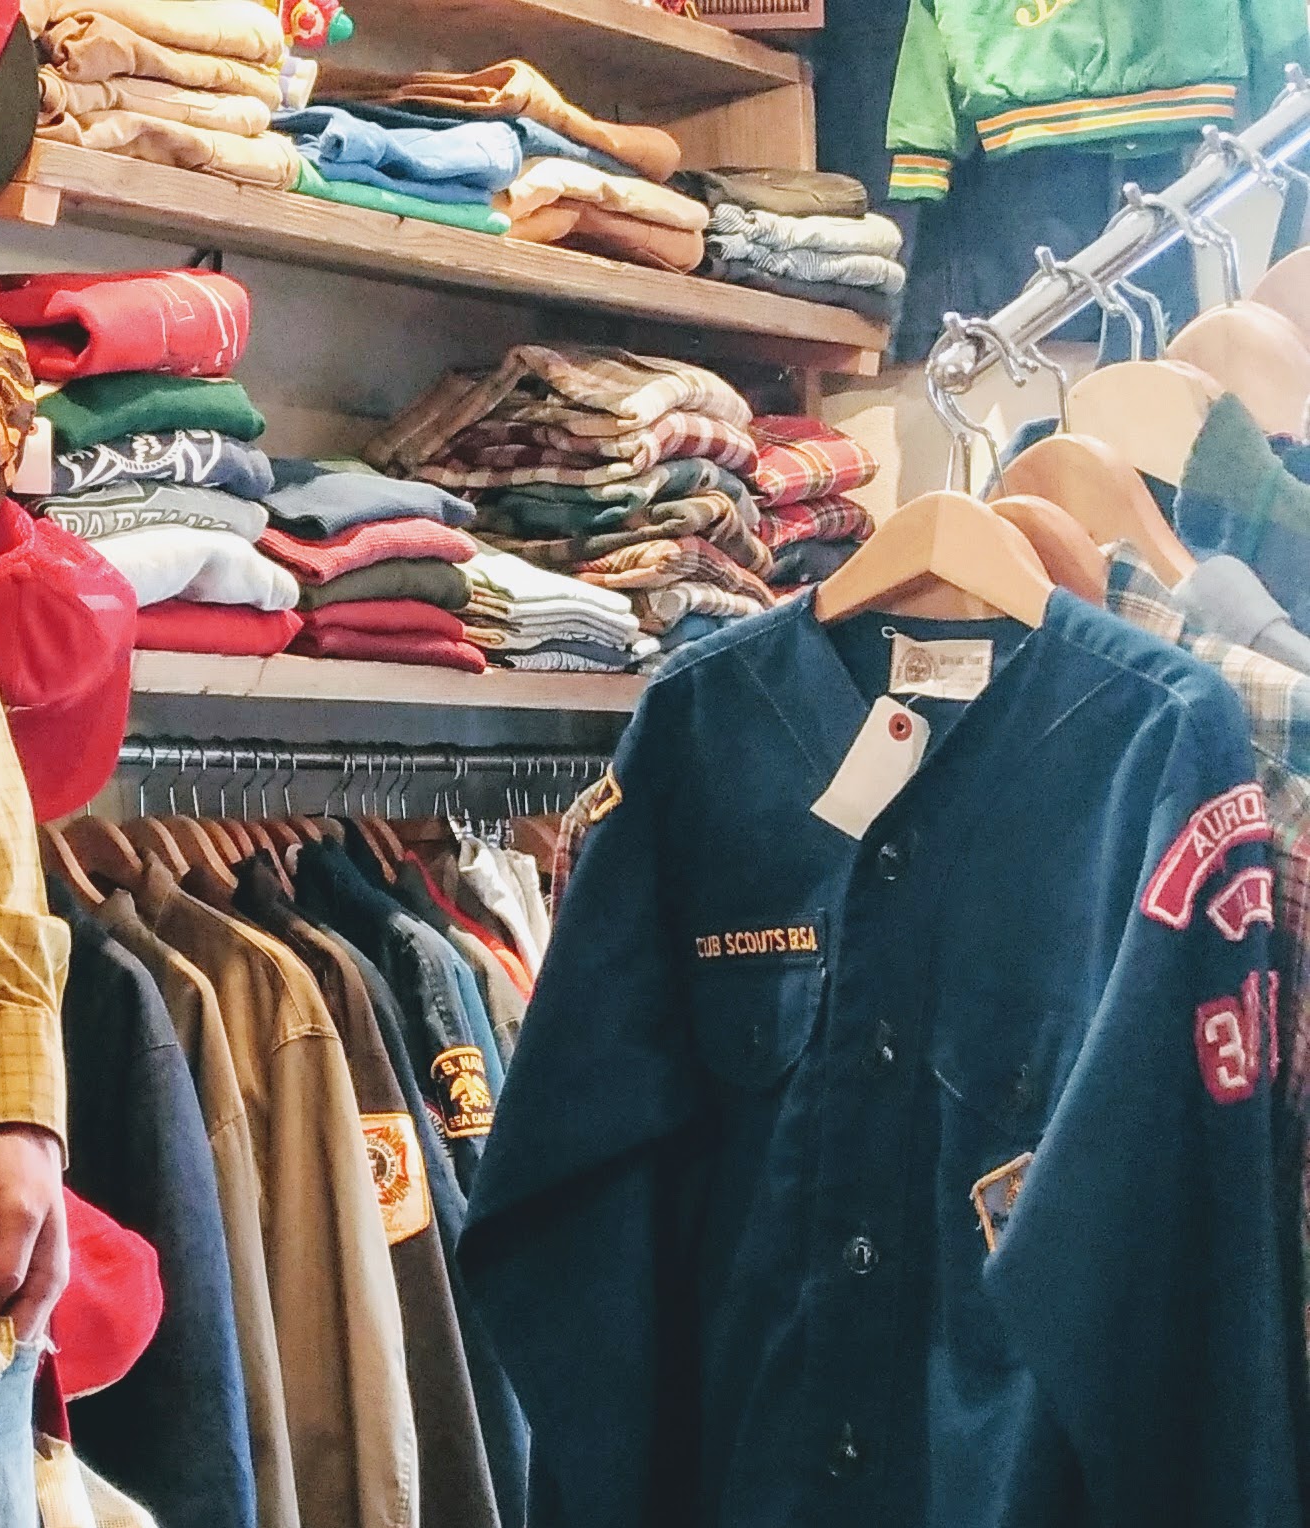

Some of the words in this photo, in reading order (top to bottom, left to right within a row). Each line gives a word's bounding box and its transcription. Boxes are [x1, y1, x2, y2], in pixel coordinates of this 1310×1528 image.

[1192, 791, 1267, 859] AURO
[695, 934, 722, 958] CUB
[724, 928, 787, 955] SCOUTS
[787, 926, 818, 952] BSA
[448, 1113, 471, 1127] SEA
